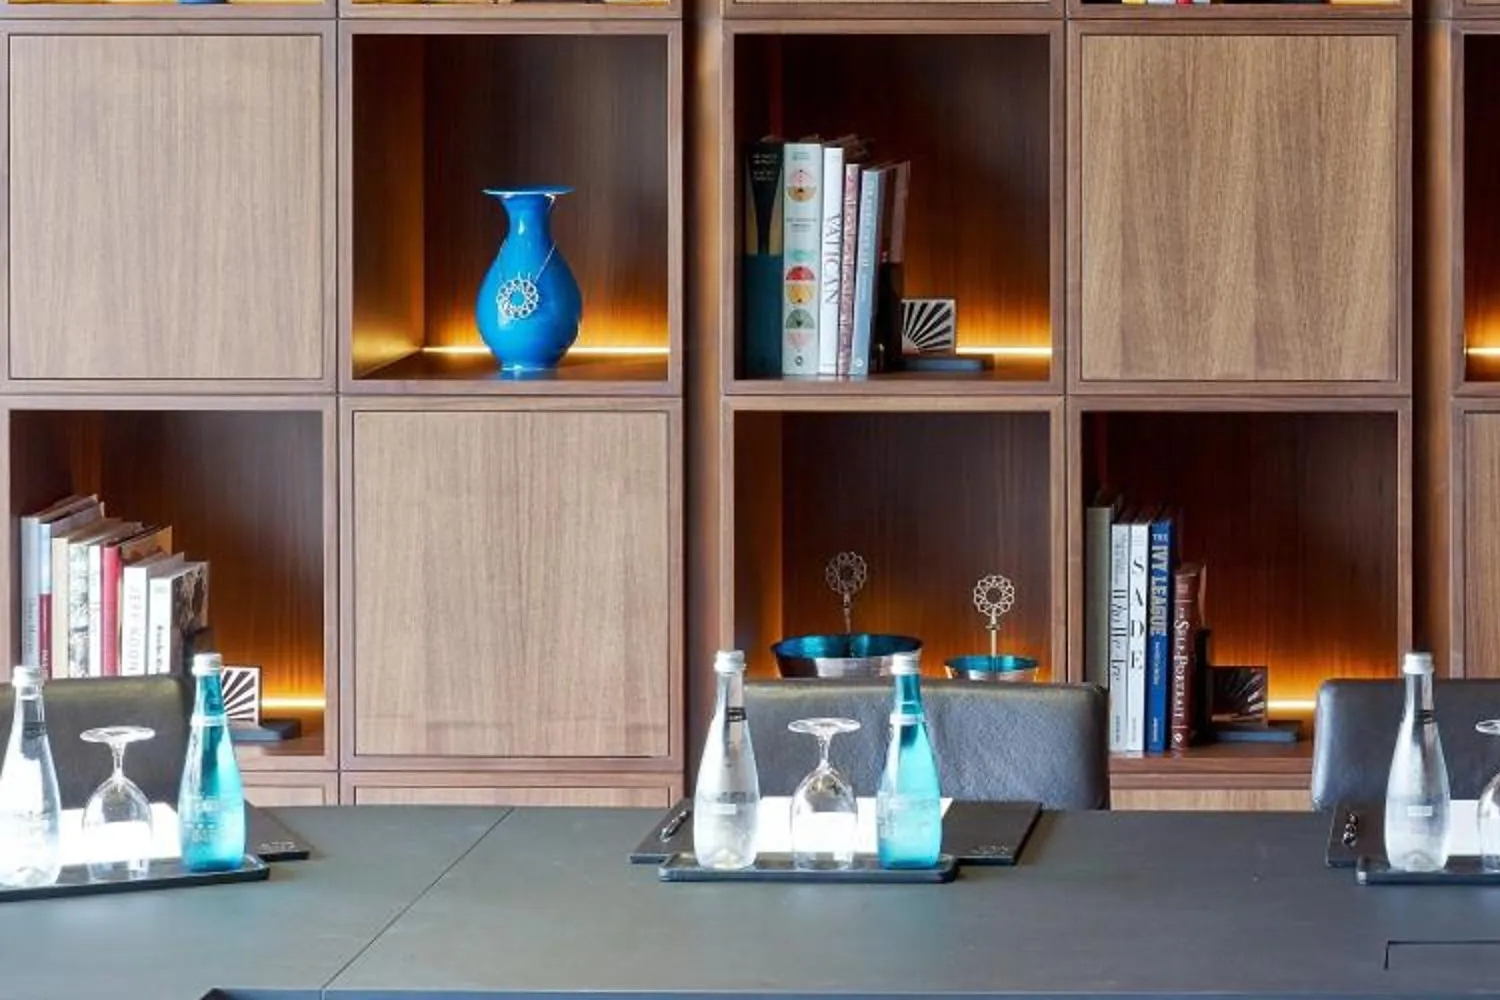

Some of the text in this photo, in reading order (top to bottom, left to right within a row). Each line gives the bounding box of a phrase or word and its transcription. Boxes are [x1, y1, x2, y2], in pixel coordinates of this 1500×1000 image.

[824, 213, 841, 306] VATICAN
[1151, 545, 1168, 572] IVY
[1152, 533, 1168, 542] THE
[1150, 575, 1168, 637] LEAGUE
